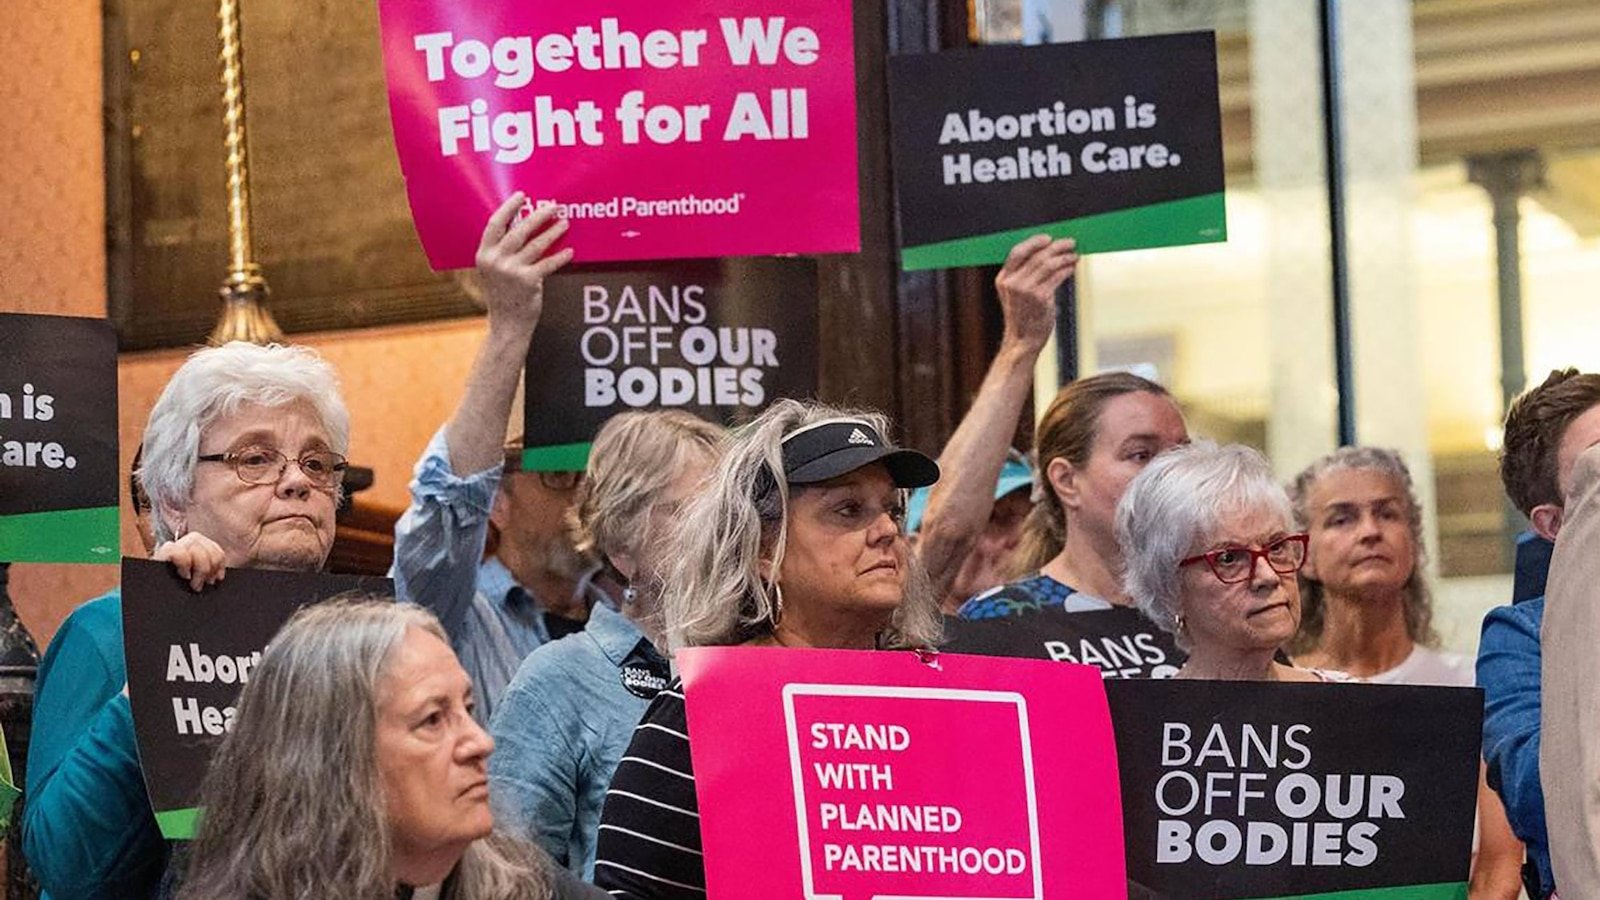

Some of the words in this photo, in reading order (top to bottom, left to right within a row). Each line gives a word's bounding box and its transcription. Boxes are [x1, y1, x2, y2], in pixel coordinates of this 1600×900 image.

[414, 17, 708, 89] Together
[720, 17, 820, 66] We
[437, 97, 603, 164] Fight
[616, 91, 710, 144] for
[723, 88, 809, 141] All
[938, 101, 1116, 145] Abortion
[1124, 95, 1157, 129] is
[942, 144, 1072, 185] Health
[1080, 142, 1182, 173] Care.
[622, 194, 739, 217] Parenthood
[583, 285, 707, 324] BANS
[580, 326, 673, 366] OFF
[679, 326, 779, 367] OUR
[23, 383, 54, 421] is
[584, 366, 765, 407] BODIES
[0, 438, 77, 470] are.
[1043, 632, 1166, 669] BANS
[810, 722, 911, 751] STAND
[1161, 722, 1312, 770] BANS
[814, 762, 893, 790] WITH
[1155, 770, 1267, 816] OFF
[1275, 773, 1406, 819] OUR
[820, 803, 962, 834] PLANNED
[824, 844, 1026, 875] PARENTHOOD
[1156, 819, 1381, 868] BODIES
